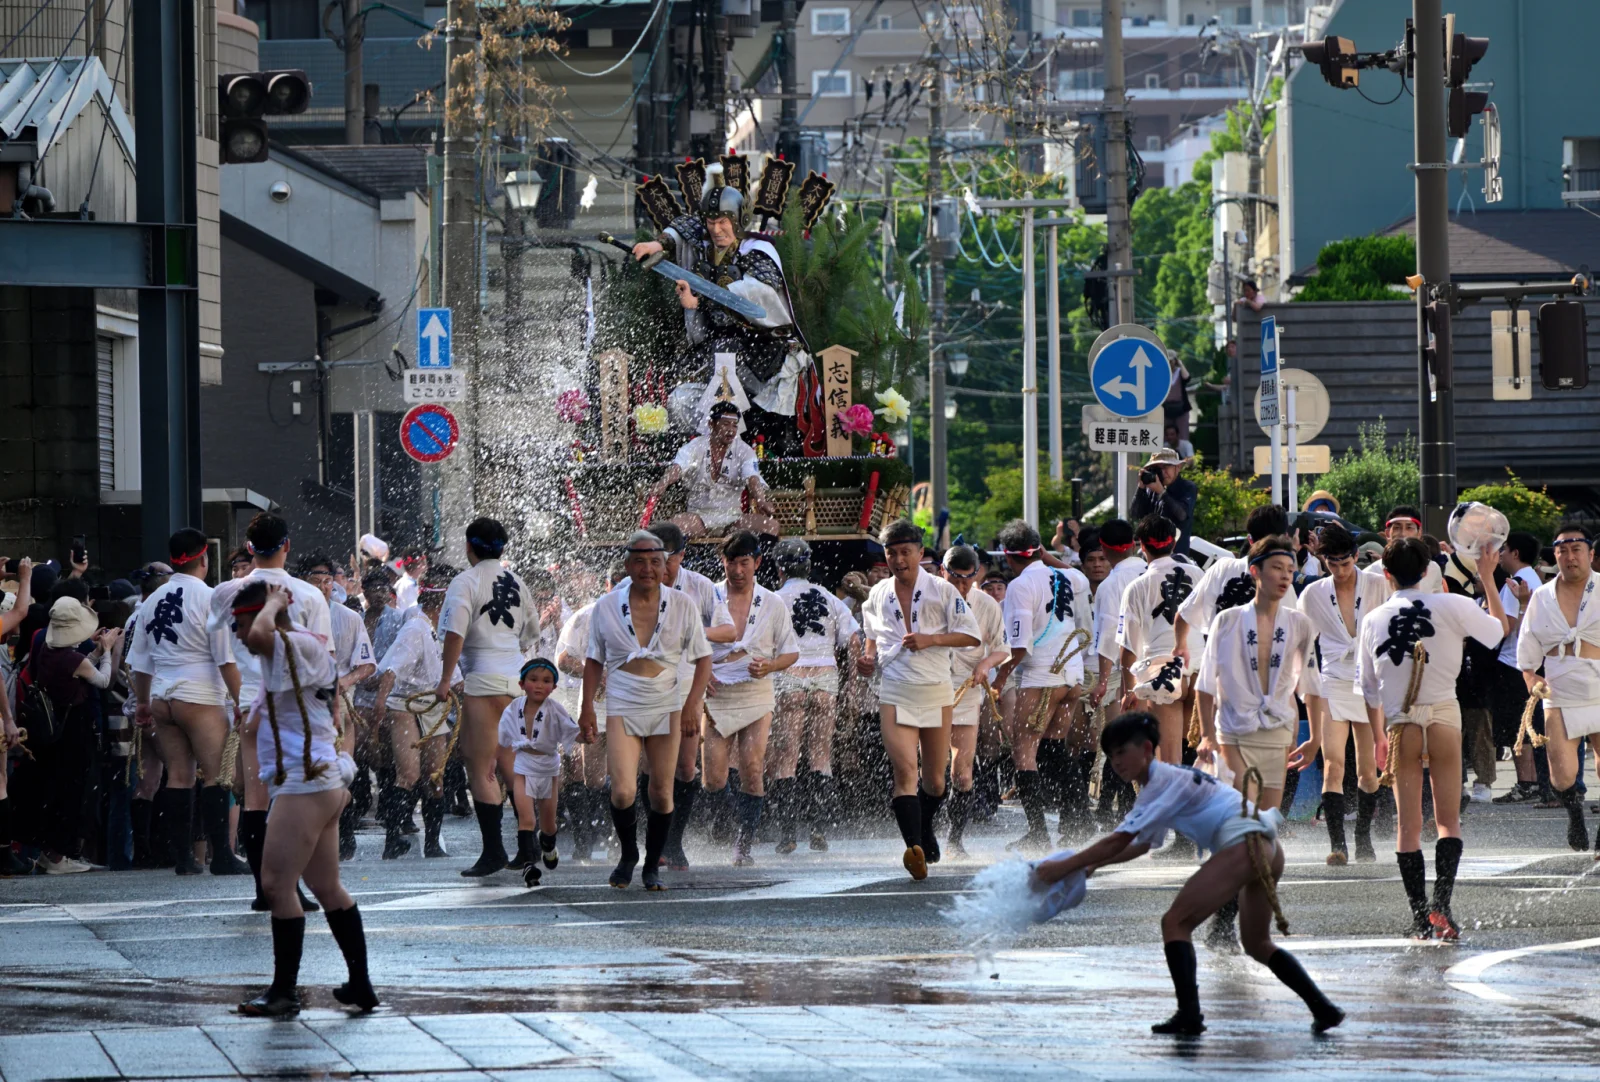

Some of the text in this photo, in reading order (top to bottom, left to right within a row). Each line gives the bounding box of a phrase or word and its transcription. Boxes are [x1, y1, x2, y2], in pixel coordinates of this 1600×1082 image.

[687, 169, 704, 205] 祇園
[1094, 427, 1158, 447] 軽車両を除く
[479, 568, 521, 630] 東
